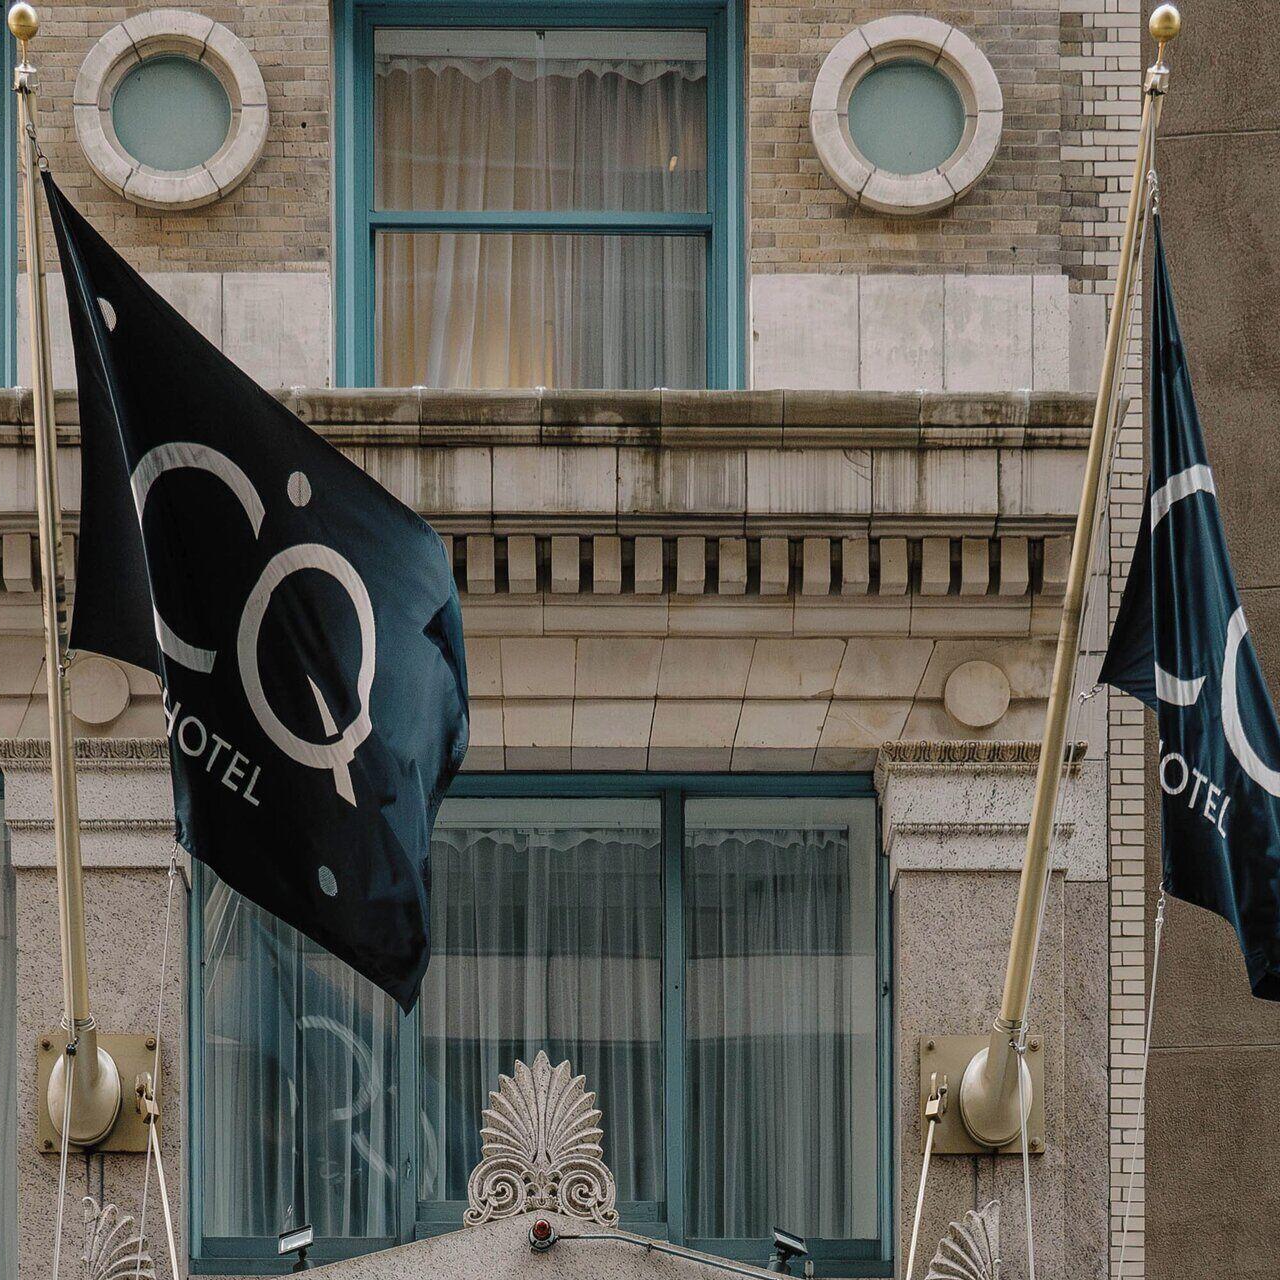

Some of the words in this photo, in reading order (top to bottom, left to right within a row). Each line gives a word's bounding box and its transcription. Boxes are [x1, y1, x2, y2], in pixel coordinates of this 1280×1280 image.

[130, 441, 377, 808] CQ
[162, 687, 262, 807] HOTEL
[1159, 739, 1231, 839] OTEL
